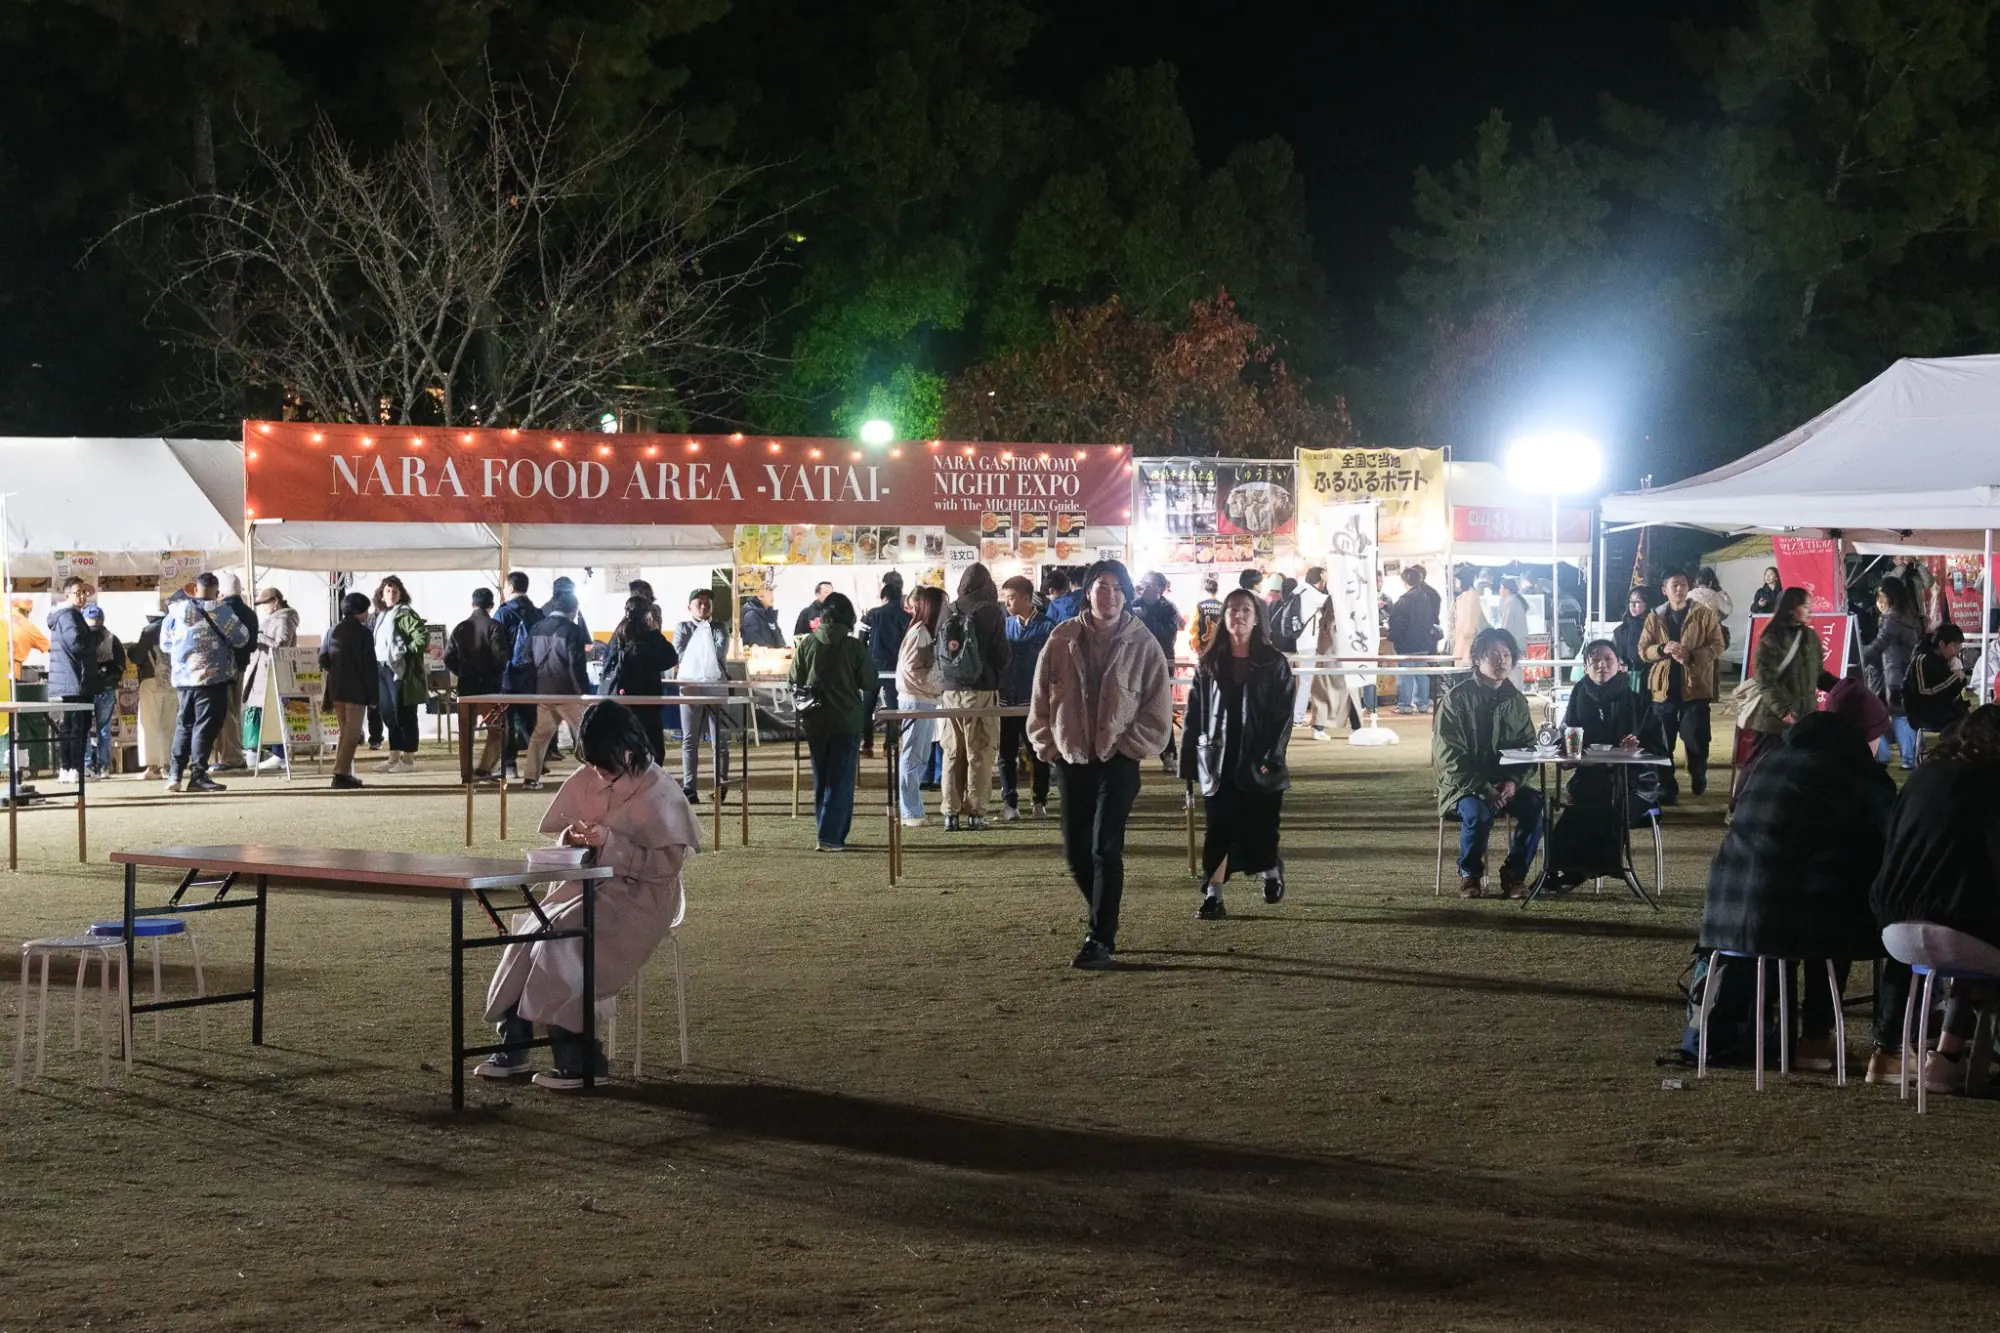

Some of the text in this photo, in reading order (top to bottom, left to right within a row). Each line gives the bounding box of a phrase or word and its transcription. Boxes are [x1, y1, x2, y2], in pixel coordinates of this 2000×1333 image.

[933, 455, 1078, 472] NARA GASTRONOMY
[1341, 452, 1401, 469] 全国ご当地
[330, 454, 890, 502] NARA FOOD AREA -YATAI-
[933, 472, 1080, 497] NIGHT EXPO
[1313, 470, 1429, 493] ふるふるポテト
[934, 498, 1080, 512] with The MICHELIN Guide
[950, 549, 975, 561] 注文口
[290, 733, 312, 742] ¥500
